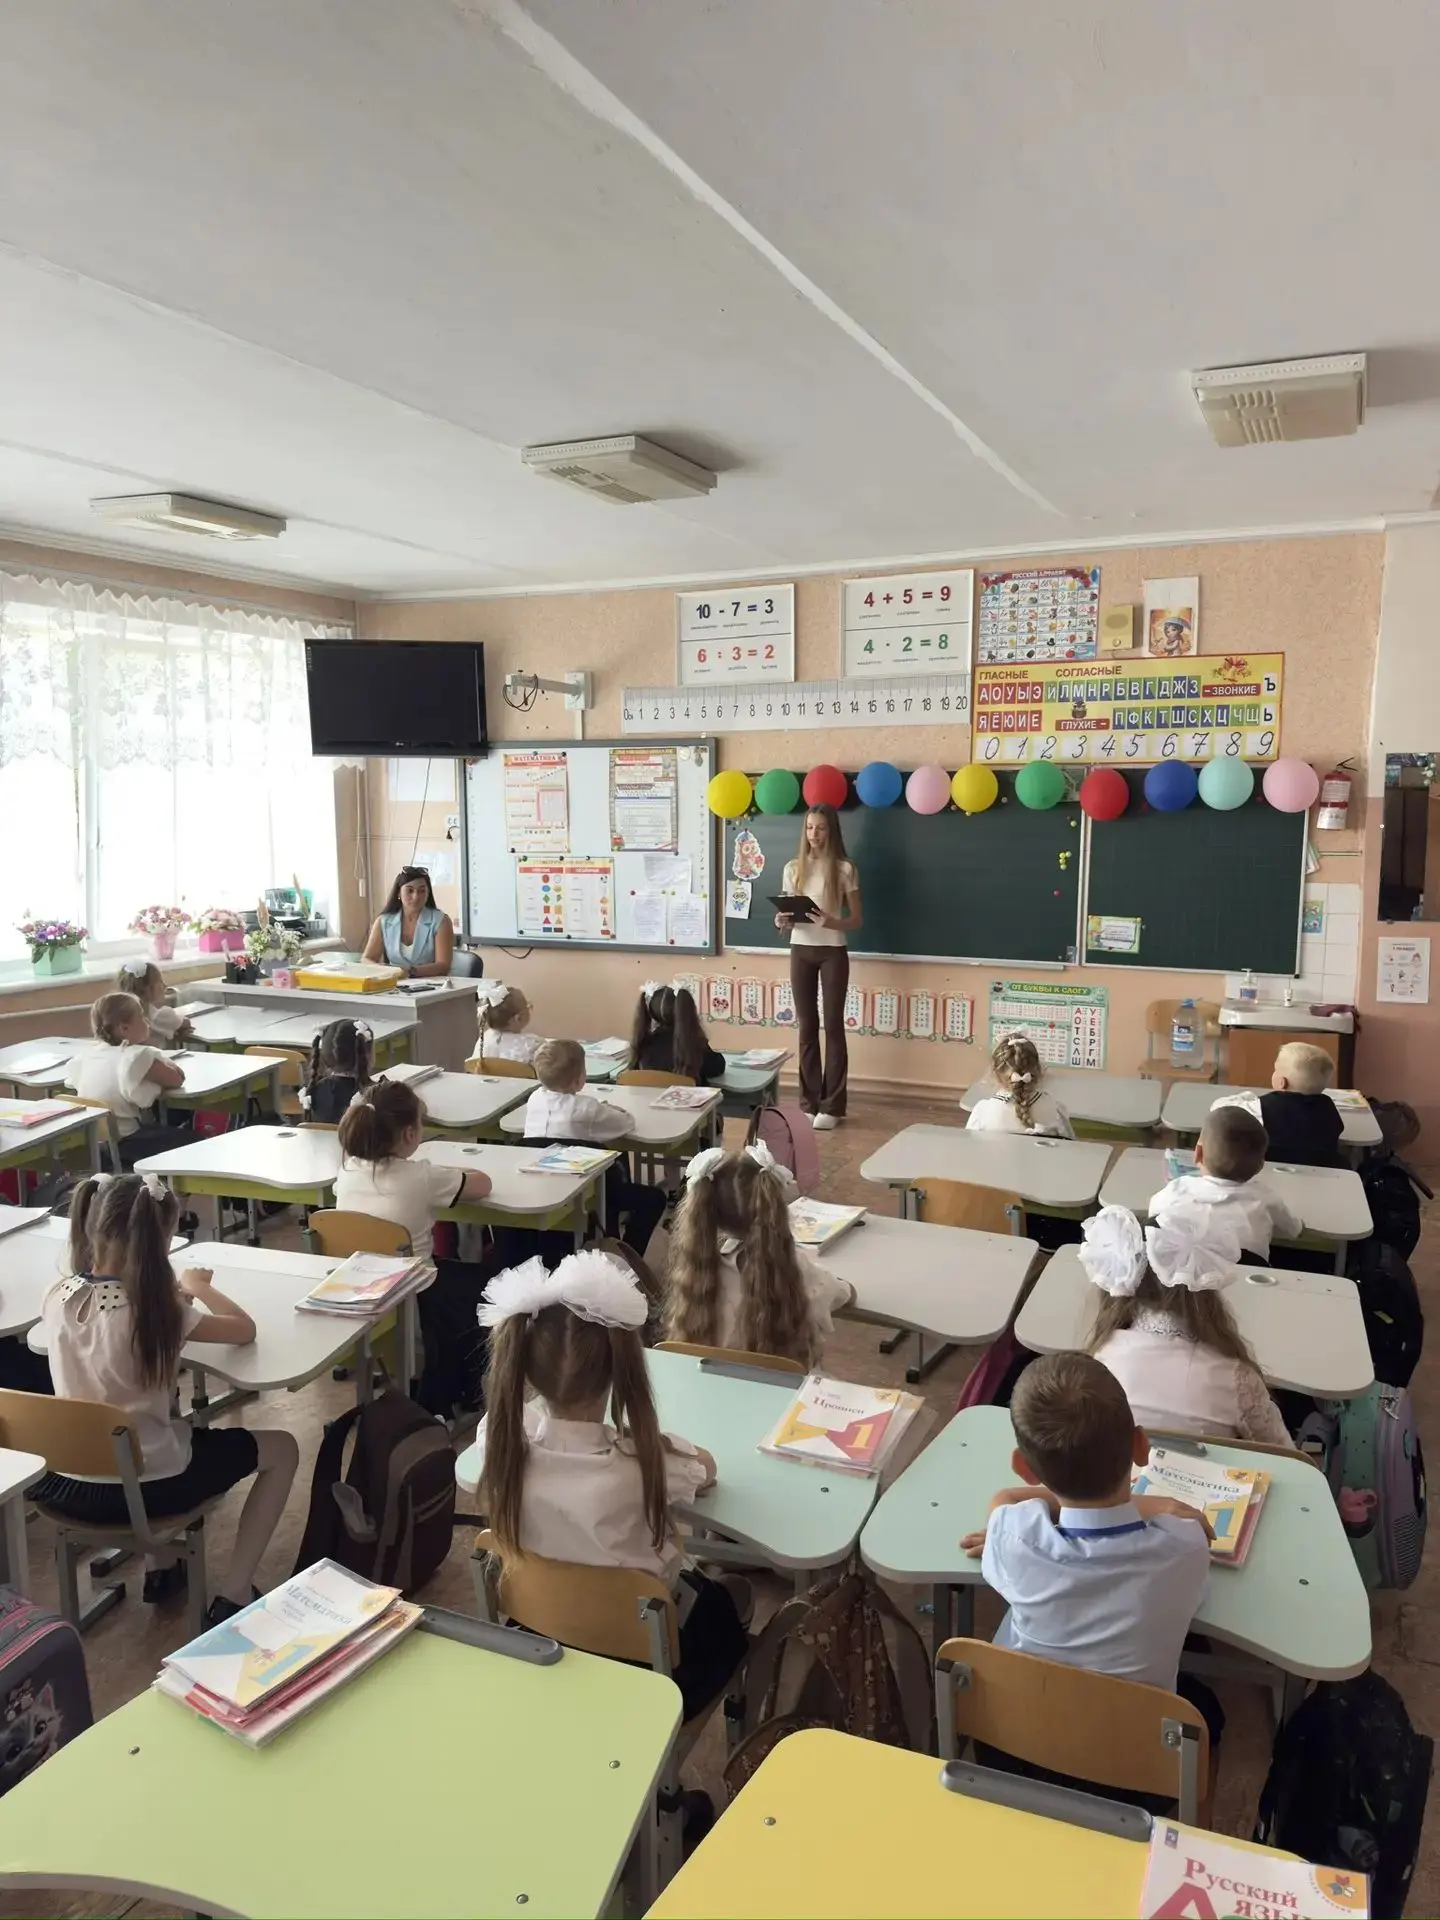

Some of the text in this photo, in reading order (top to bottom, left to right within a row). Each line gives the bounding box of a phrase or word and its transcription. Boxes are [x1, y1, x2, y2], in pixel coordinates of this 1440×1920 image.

[864, 586, 951, 607] 4 + 5 = 9
[696, 604, 711, 619] 10
[731, 602, 741, 617] 7
[747, 604, 757, 612] =
[764, 598, 774, 614] 3
[863, 639, 874, 654] 4
[902, 636, 913, 652] 2
[938, 634, 948, 649] 8
[697, 649, 707, 663] 6
[732, 646, 741, 661] 3
[764, 645, 775, 659] 2
[980, 670, 1029, 680] ГЛАСНЫЕ
[1055, 665, 1122, 678] СОГЛАСНЫЕ
[980, 679, 1198, 701] А О У Ы Э Й Л М Н Р Б В Г Д Ж З
[1212, 686, 1257, 696] ЗВОНКИЕ
[1264, 677, 1276, 692] Ъ
[639, 708, 643, 720] 1
[654, 708, 659, 720] 2
[670, 707, 675, 719] 3
[684, 707, 690, 719] 4
[701, 706, 707, 719] 5
[717, 706, 723, 718] 6
[733, 705, 739, 717] 7
[750, 704, 756, 716] 8
[766, 704, 772, 716] 9
[781, 703, 791, 716] 10
[798, 703, 806, 715] 11
[815, 702, 824, 715] 12
[832, 702, 841, 715] 13
[850, 701, 860, 714] 14
[868, 700, 877, 713] 15
[886, 700, 895, 713] 16
[904, 699, 912, 711] 17
[922, 698, 932, 711] 18
[940, 696, 950, 710] 19
[956, 696, 968, 710] 20
[1115, 708, 1259, 725] П Ф К Т Ш С Х Ц Ч Щ
[1264, 708, 1273, 722] Ь
[979, 712, 1039, 729] Я Ё Ю И Е
[1061, 720, 1097, 730] ГЛУХИЕ
[985, 730, 1275, 760] 0 1 2 3 4 5 6 7 8 9
[1074, 1016, 1081, 1025] О
[1090, 1008, 1096, 1016] У
[1090, 1018, 1096, 1026] Е
[1074, 1027, 1080, 1035] Т
[1090, 1028, 1096, 1036] Б
[1073, 1037, 1080, 1045] С
[1090, 1038, 1096, 1046] Р
[1072, 1057, 1081, 1065] Ш
[1086, 1058, 1096, 1067] М
[813, 1396, 864, 1415] Прописи
[846, 1423, 874, 1449] 1
[1151, 1465, 1240, 1493] Математика
[1209, 1508, 1234, 1538] 1
[248, 1644, 317, 1686] 1
[1183, 1857, 1297, 1909] Русский
[1234, 1900, 1312, 1920] язы
